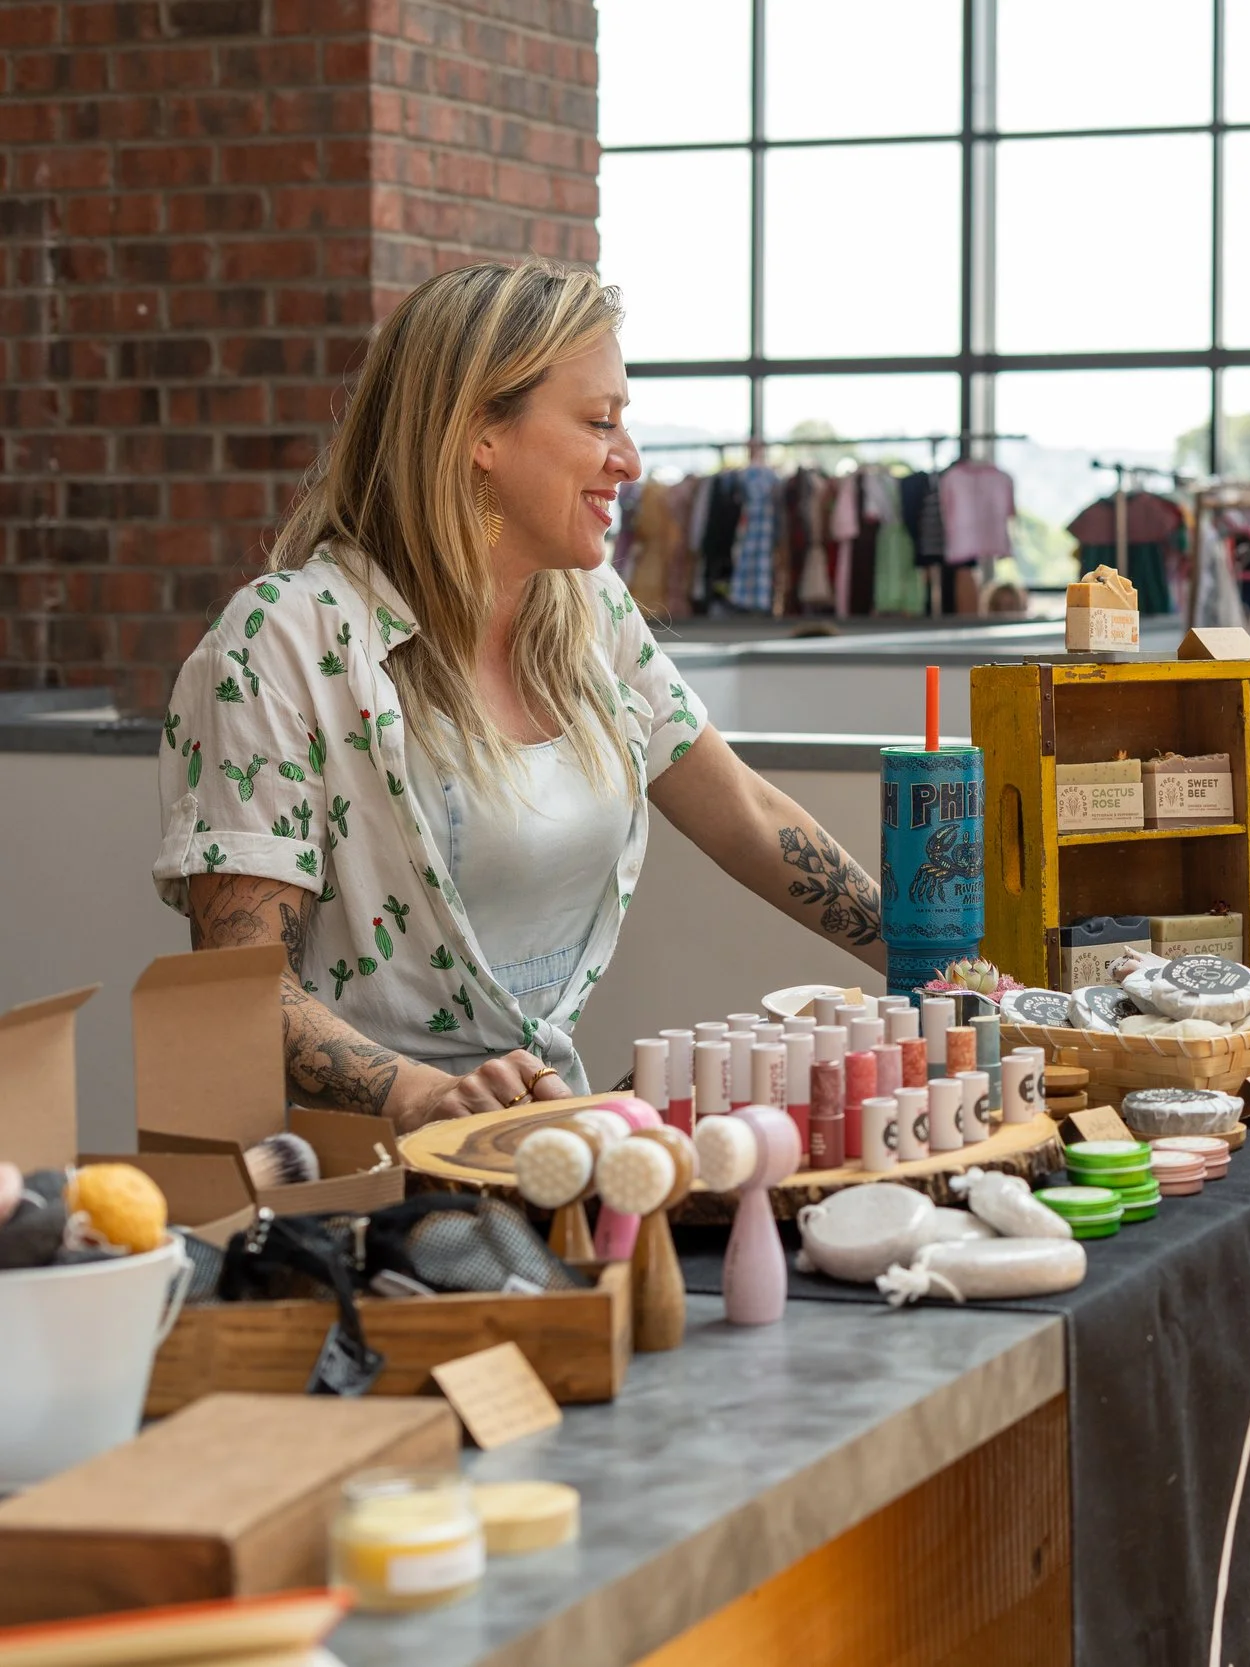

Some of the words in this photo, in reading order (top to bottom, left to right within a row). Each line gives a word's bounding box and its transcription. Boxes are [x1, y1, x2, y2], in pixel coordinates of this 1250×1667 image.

[1187, 779, 1218, 788] SWEET
[1092, 788, 1135, 797] CACTUS
[1160, 777, 1175, 788] TREE
[1176, 780, 1184, 807] SOAPS
[1188, 789, 1206, 797] BEE
[910, 779, 984, 830] PHI
[1092, 800, 1120, 808] ROSE
[1194, 942, 1234, 954] CACTUS
[1075, 953, 1092, 964] TREE
[1092, 955, 1100, 982] SOAPS
[1183, 959, 1222, 967] SOAPS
